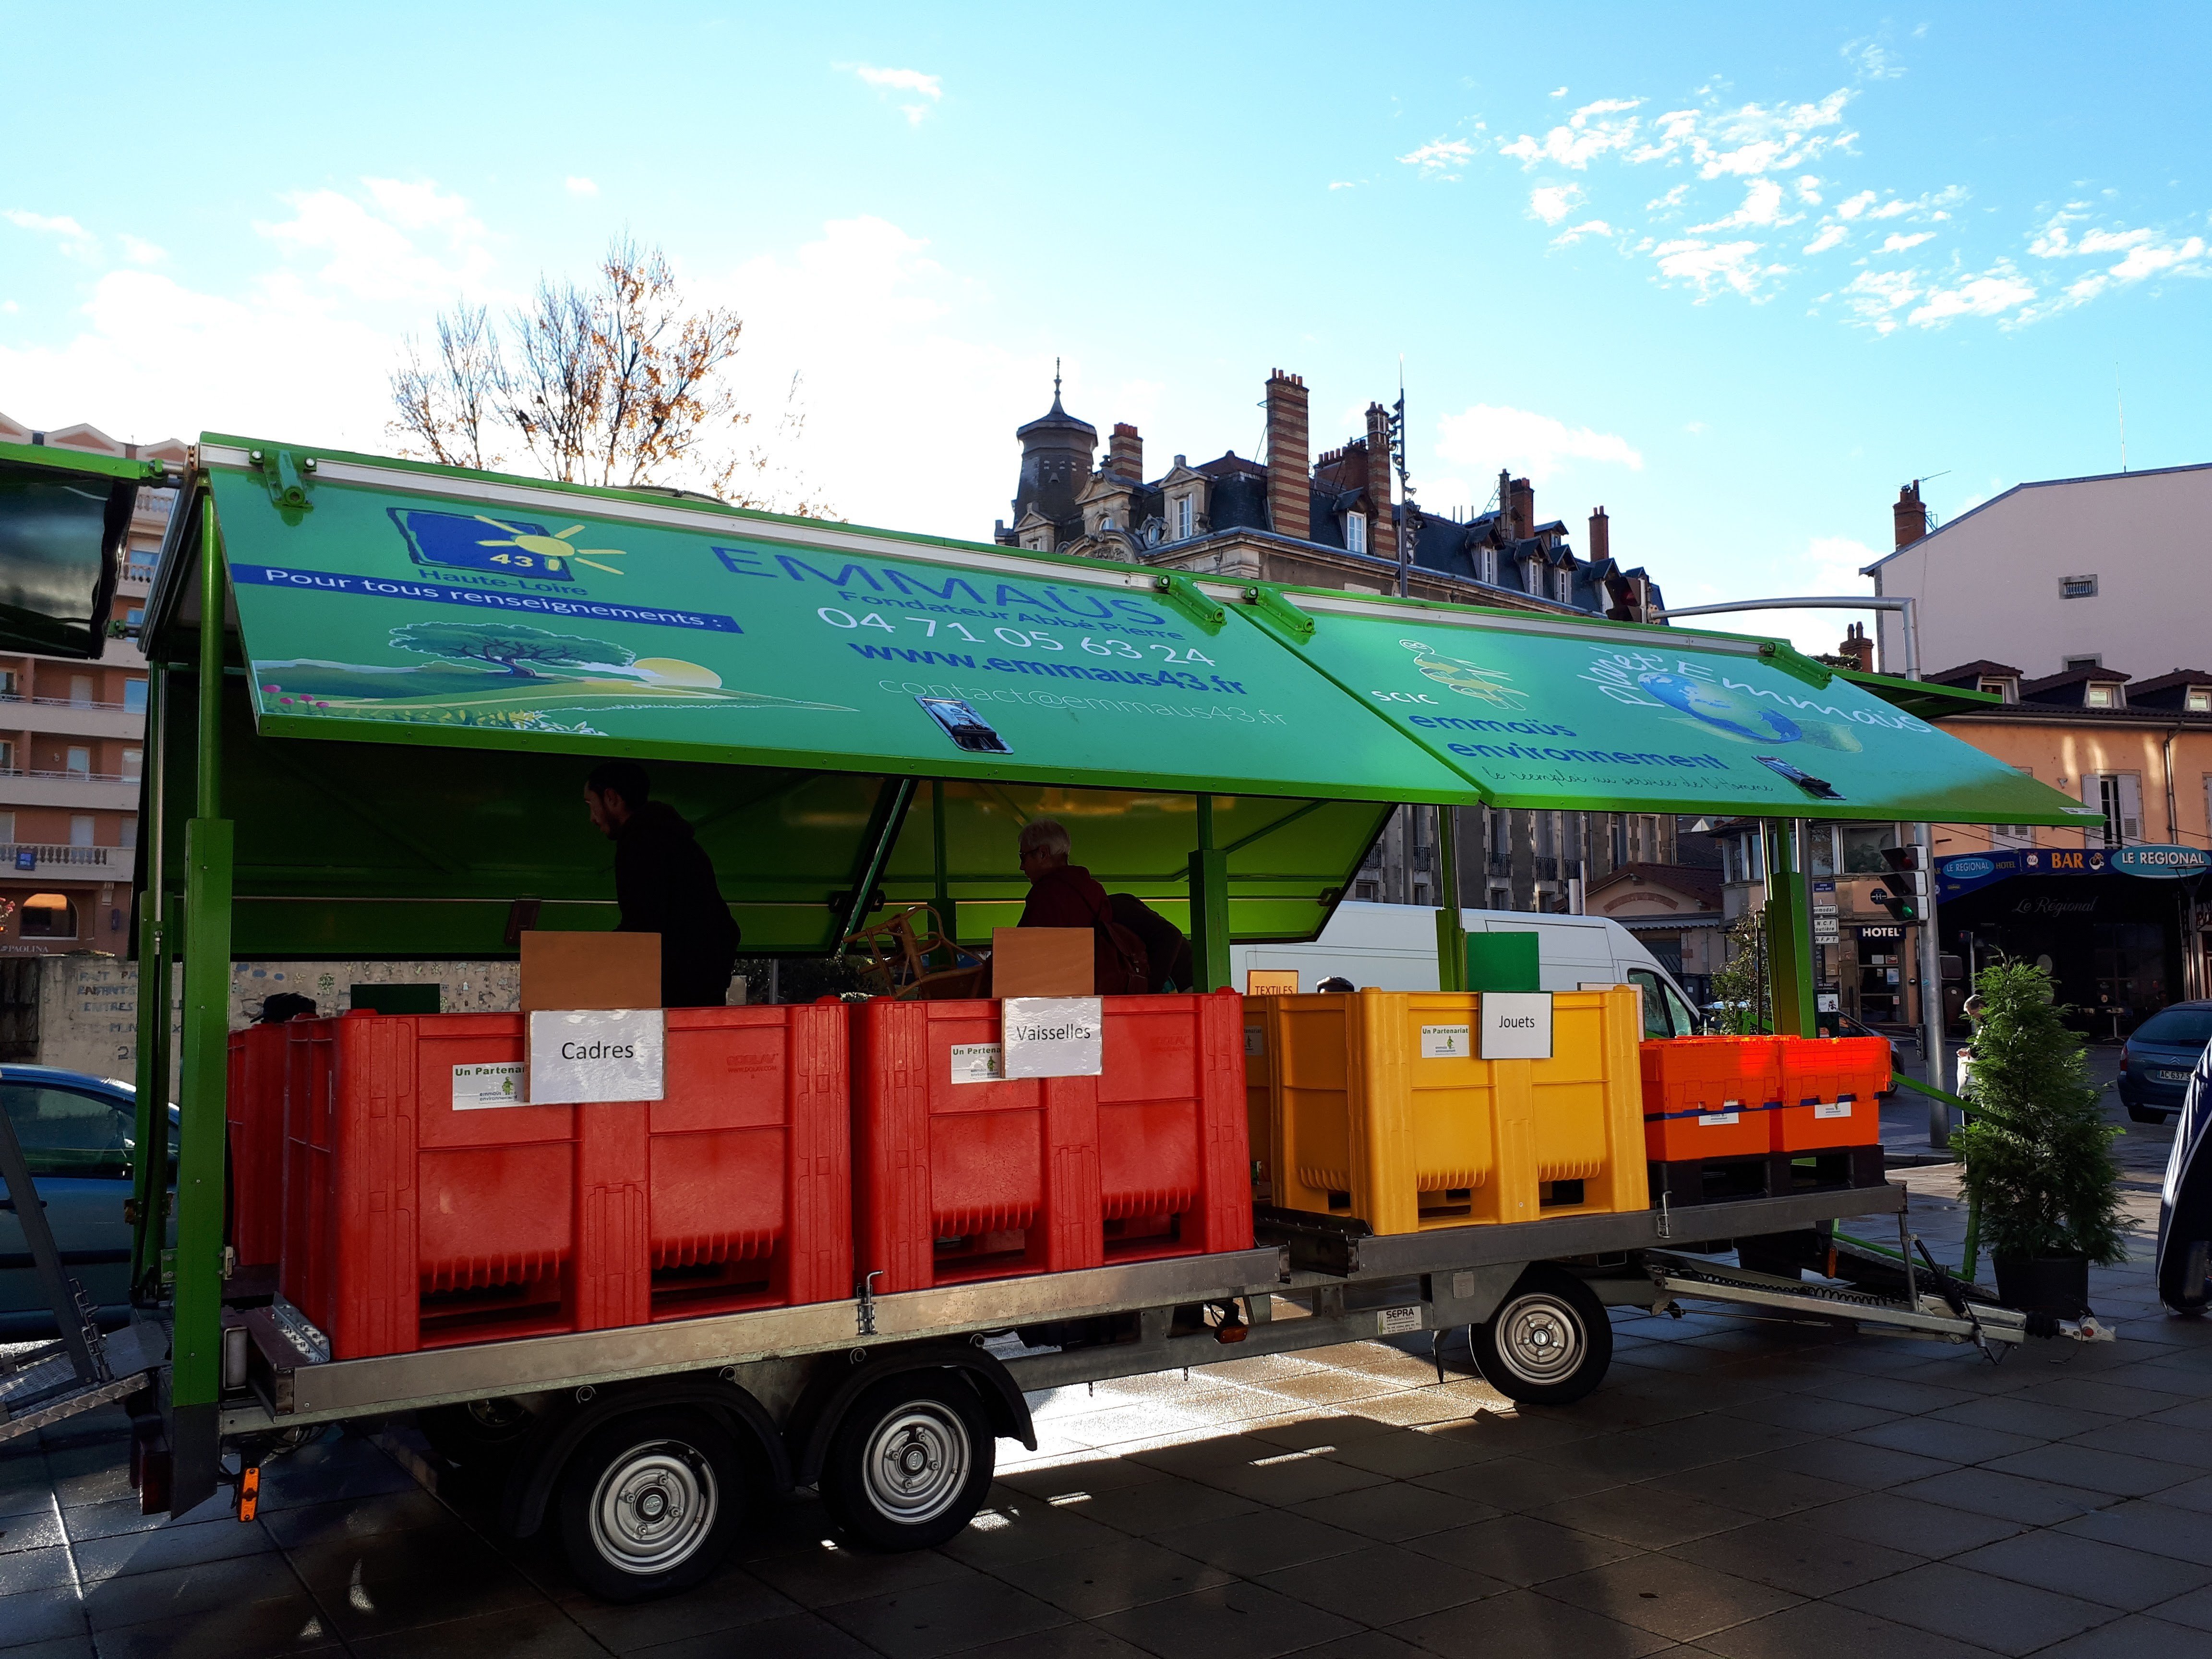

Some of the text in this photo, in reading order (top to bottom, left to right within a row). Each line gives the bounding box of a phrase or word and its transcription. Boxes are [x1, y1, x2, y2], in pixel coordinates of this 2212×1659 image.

[489, 553, 533, 567] 43
[419, 568, 589, 596] Haute-Loire
[710, 546, 1166, 625] EMMAÜS
[265, 569, 352, 589] Pour
[361, 579, 439, 598] tous
[449, 589, 705, 626] renseignements
[838, 590, 1186, 641] Fondateur Abbé Pierre
[817, 607, 1216, 667] 04 71 05 63 24
[846, 642, 1248, 695] www.emmaus43.fr
[878, 679, 1287, 725] contact@emmaus43.fr
[1408, 714, 1577, 738] emmaüs
[1446, 741, 1731, 770] environnement
[1947, 864, 1954, 872] LE
[1956, 862, 1989, 872] REGIONAL
[1996, 861, 2016, 869] HOTEL
[2051, 852, 2085, 868] BAR
[2122, 851, 2205, 865] LE REGIONAL
[2012, 898, 2032, 914] Le
[1862, 927, 1900, 937] HOTEL
[1254, 986, 1293, 995] TEXTILES
[1499, 1015, 1535, 1028] Jouets
[1016, 1023, 1091, 1041] Vaisselles
[562, 1040, 634, 1059] Cadres
[456, 1068, 470, 1076] Un
[1386, 1308, 1414, 1319] SEPRA
